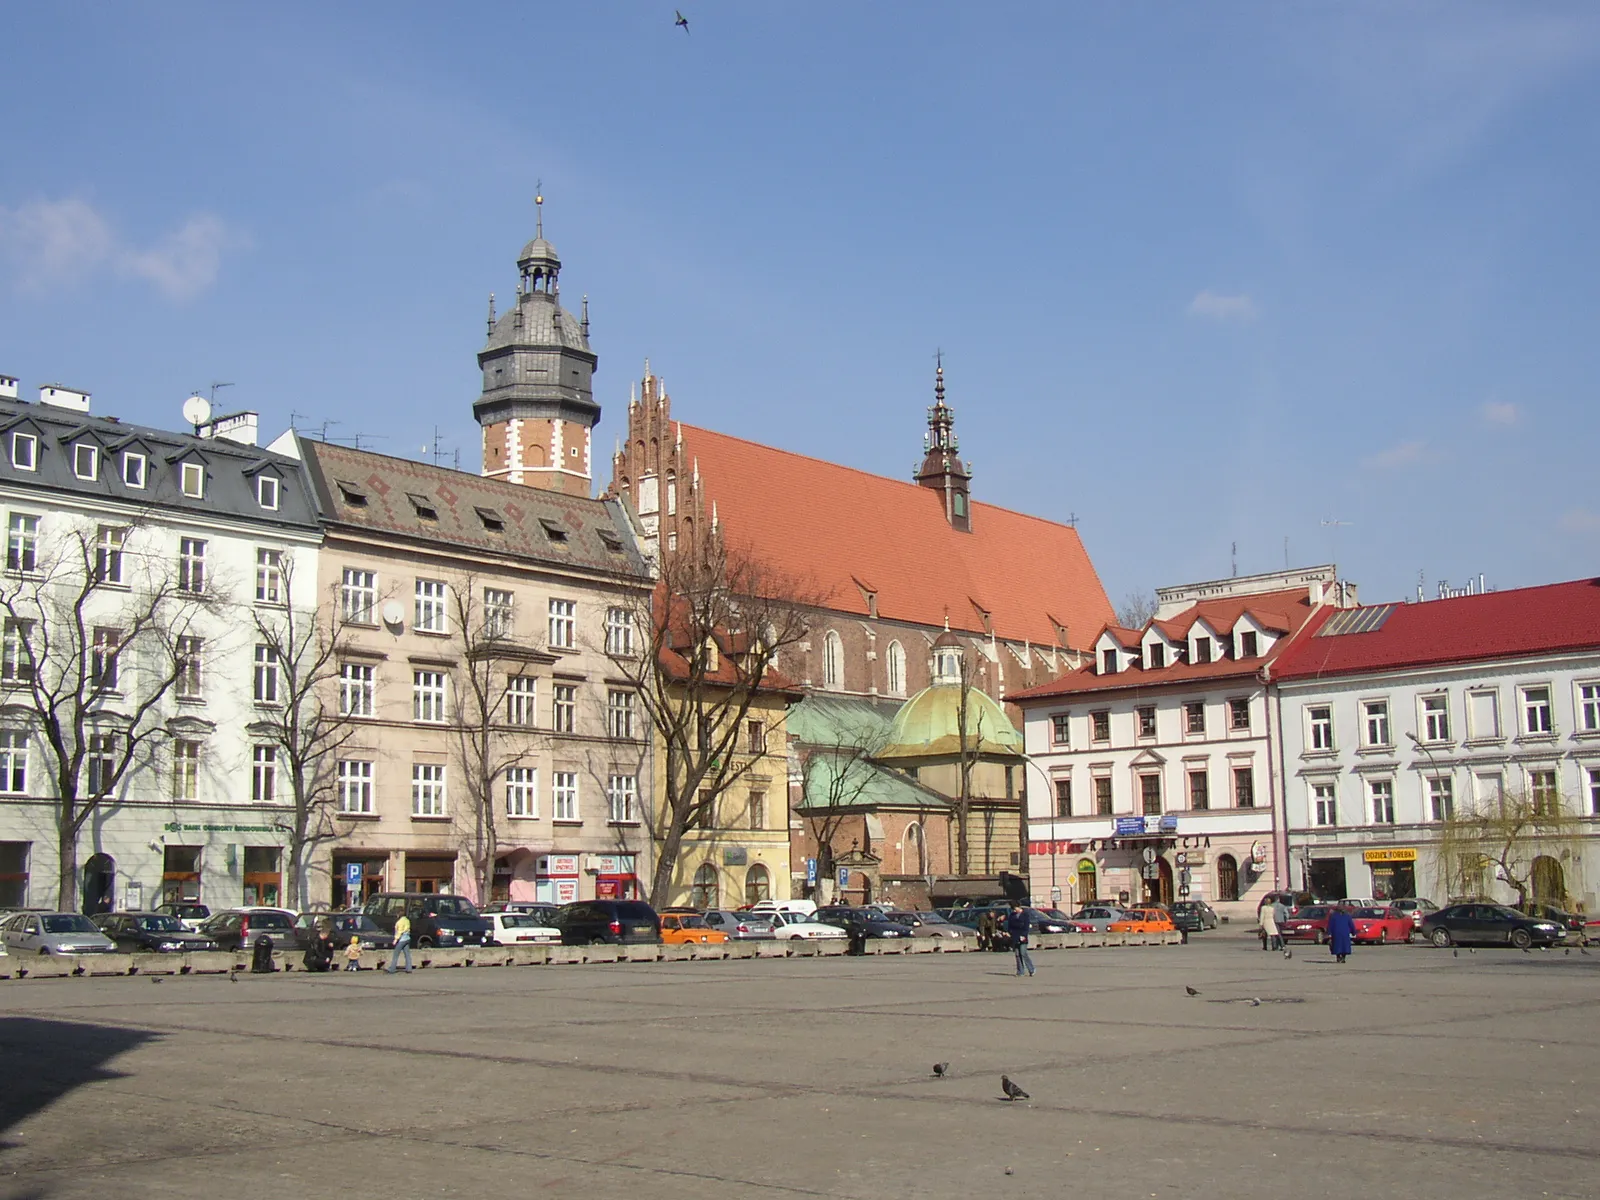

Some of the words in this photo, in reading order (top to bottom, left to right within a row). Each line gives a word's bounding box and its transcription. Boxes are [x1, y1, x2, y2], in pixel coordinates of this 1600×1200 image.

[350, 865, 359, 879] P
[809, 870, 816, 880] P
[840, 869, 847, 880] P
